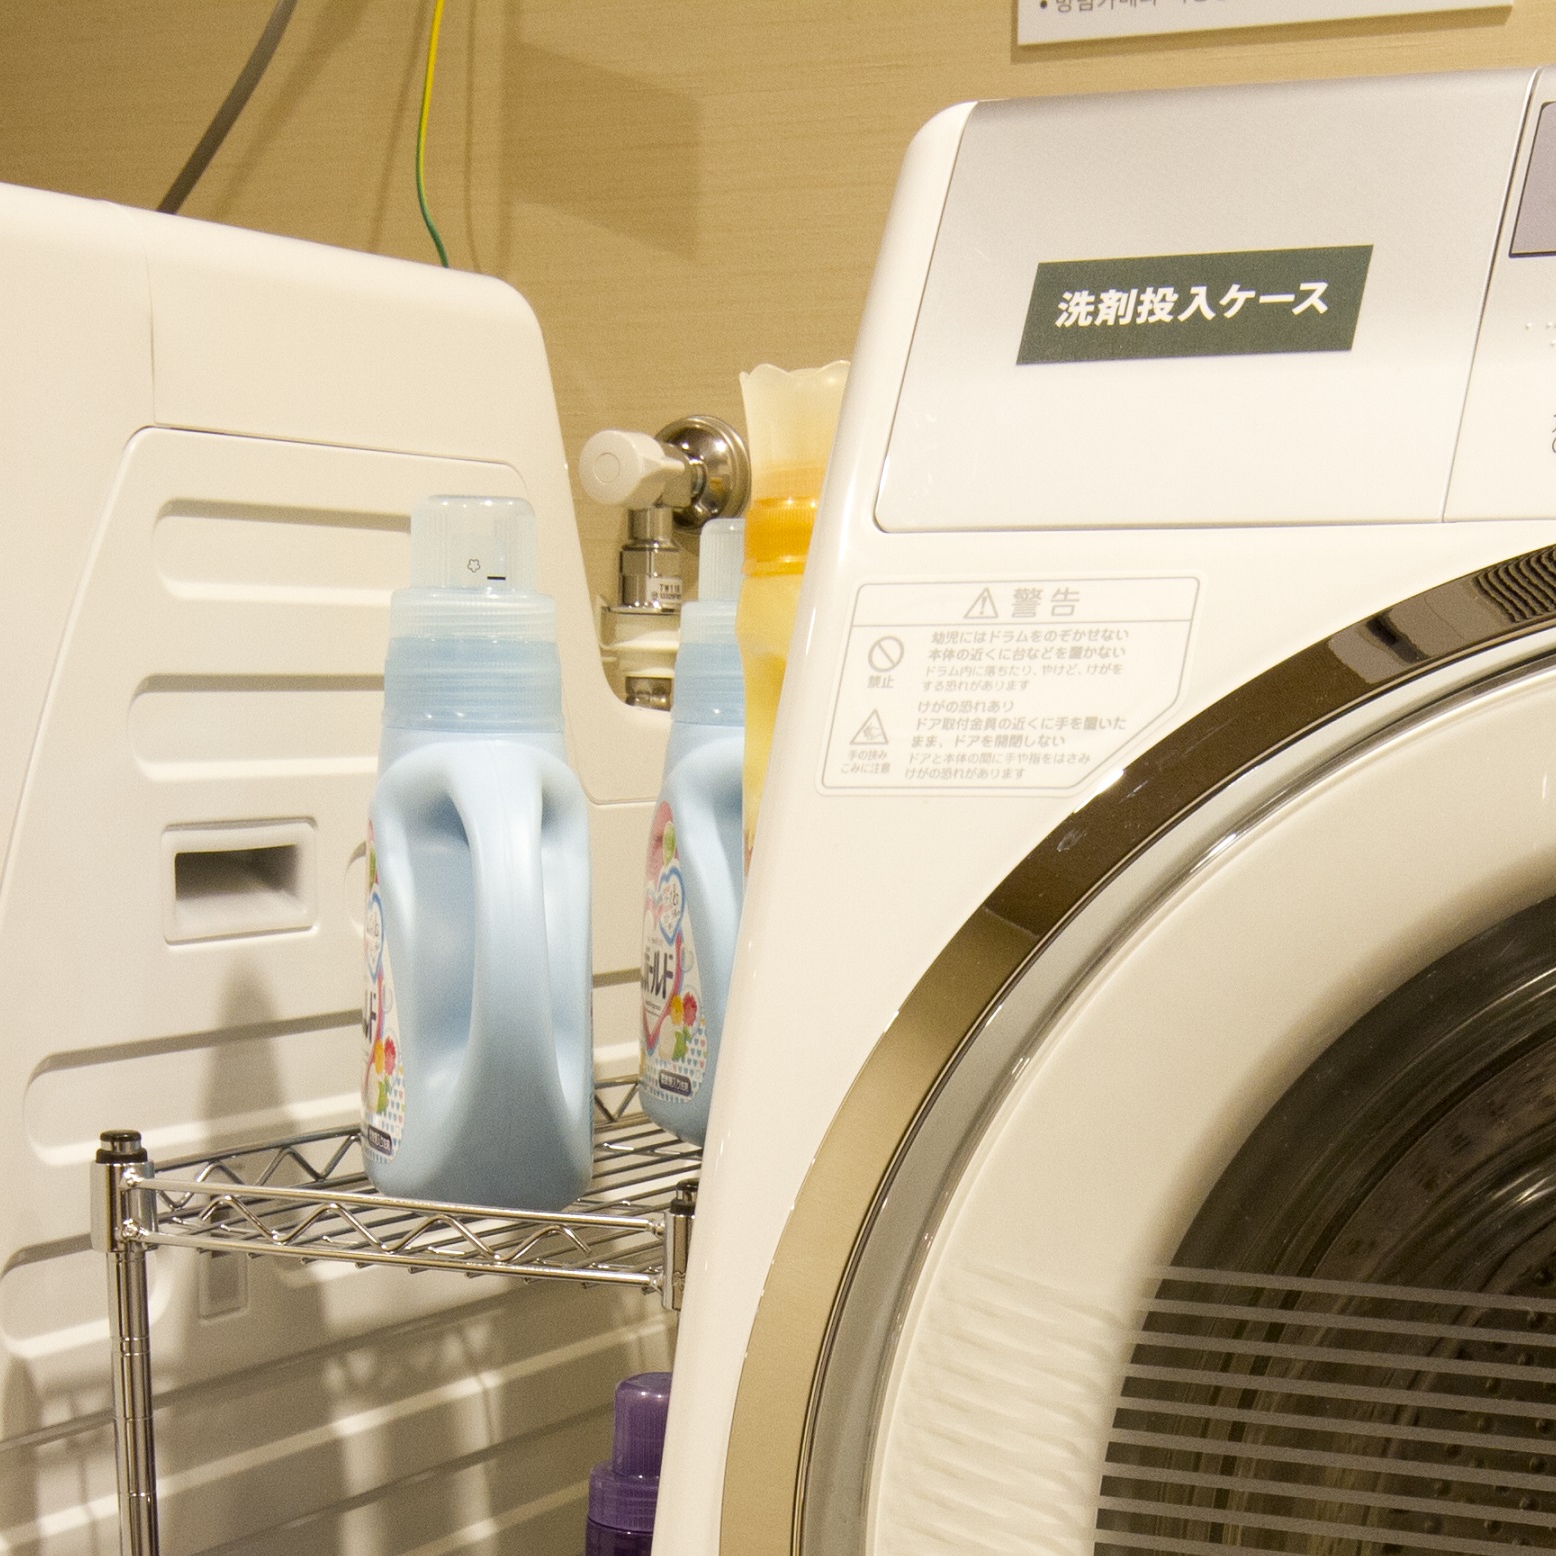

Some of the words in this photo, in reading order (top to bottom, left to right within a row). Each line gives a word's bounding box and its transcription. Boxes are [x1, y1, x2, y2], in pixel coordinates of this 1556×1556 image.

[1055, 280, 1331, 329] 洗剤投入ケース
[1011, 586, 1080, 619] 警告
[931, 628, 1130, 645] 幼児にはドラムをのぞかせない
[928, 646, 1127, 662] 本体の近くに台などを置かない
[867, 674, 895, 689] 禁止
[922, 678, 1030, 693] する恐れがあります
[917, 699, 1014, 714] けがの恐れあり
[904, 766, 1027, 781] けがの恐れがあります
